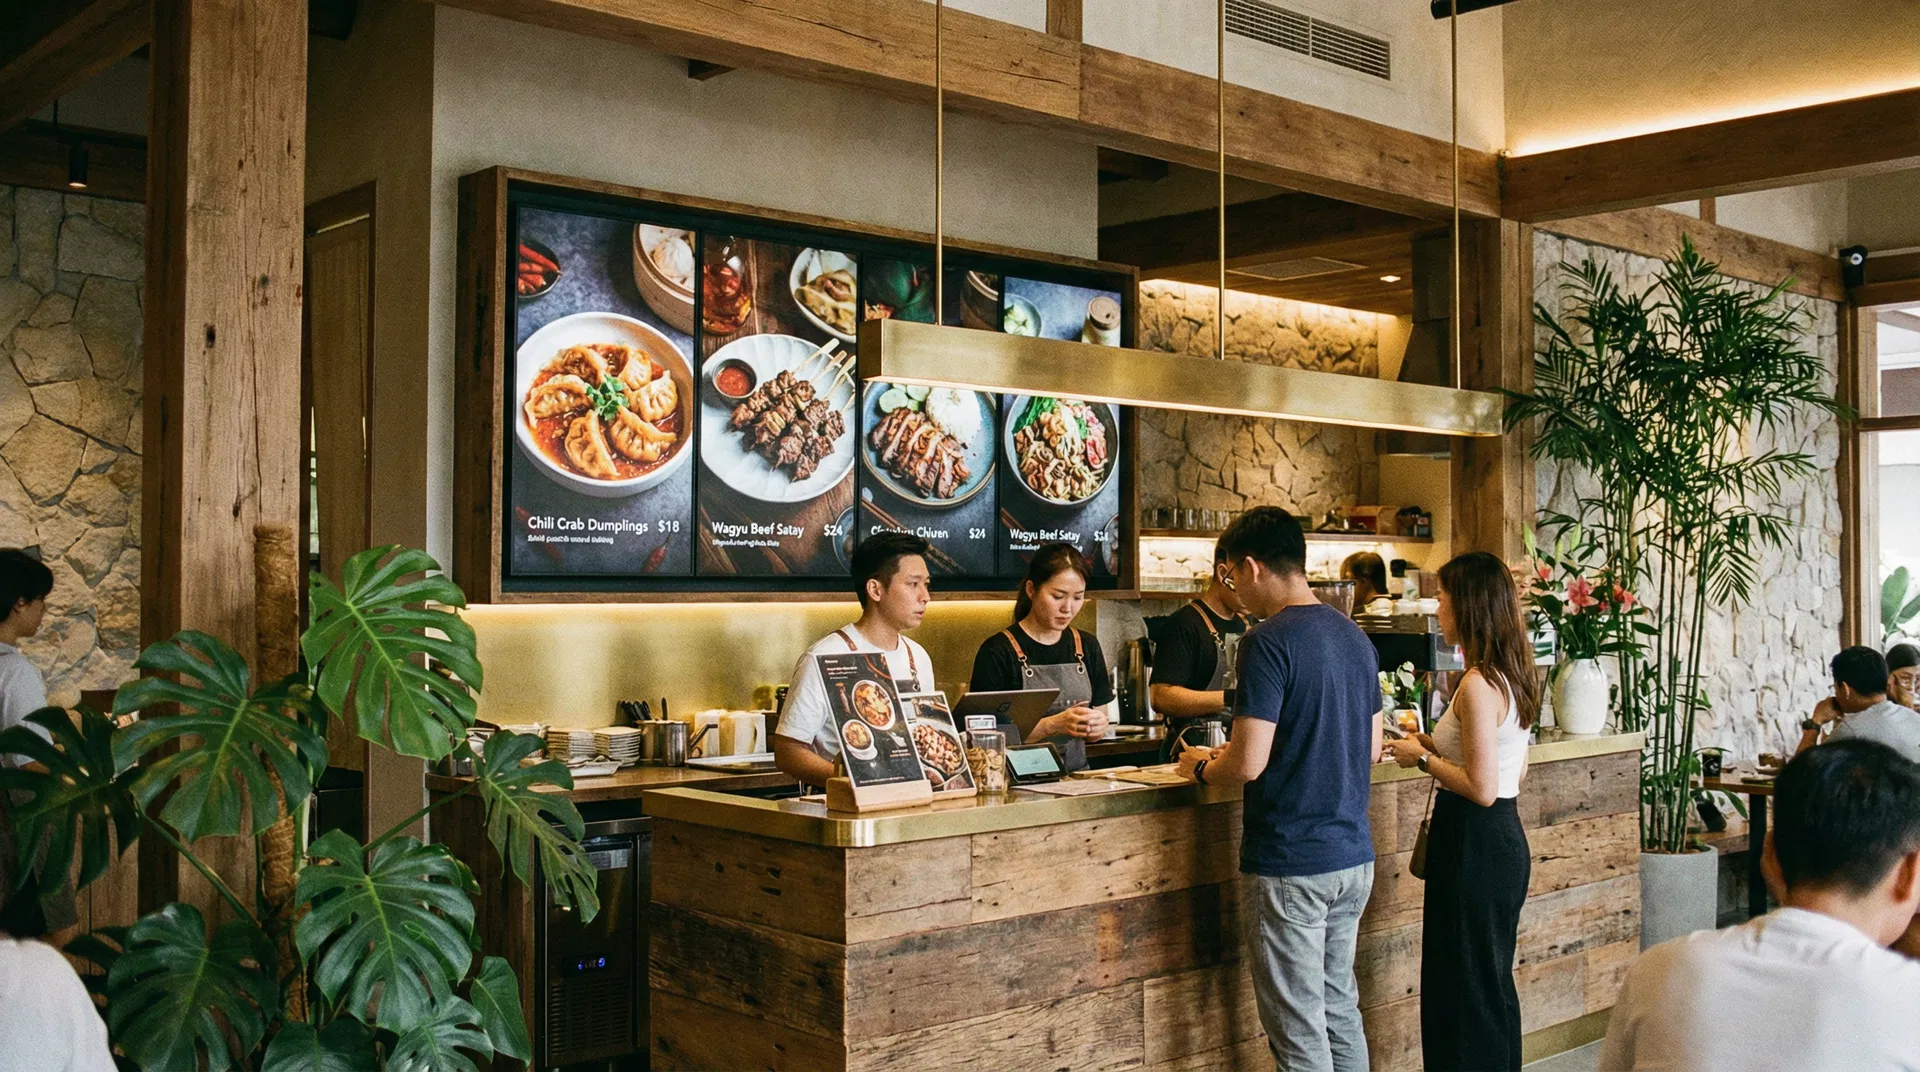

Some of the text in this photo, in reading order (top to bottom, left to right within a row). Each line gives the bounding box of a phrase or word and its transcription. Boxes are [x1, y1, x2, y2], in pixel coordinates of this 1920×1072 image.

[527, 516, 680, 535] Chili Crab Dumplings $18
[711, 521, 843, 539] Wagyu Beef Satay $24
[1009, 528, 1038, 542] Wagyu
[1040, 529, 1058, 540] Beef
[1059, 529, 1081, 543] Satay
